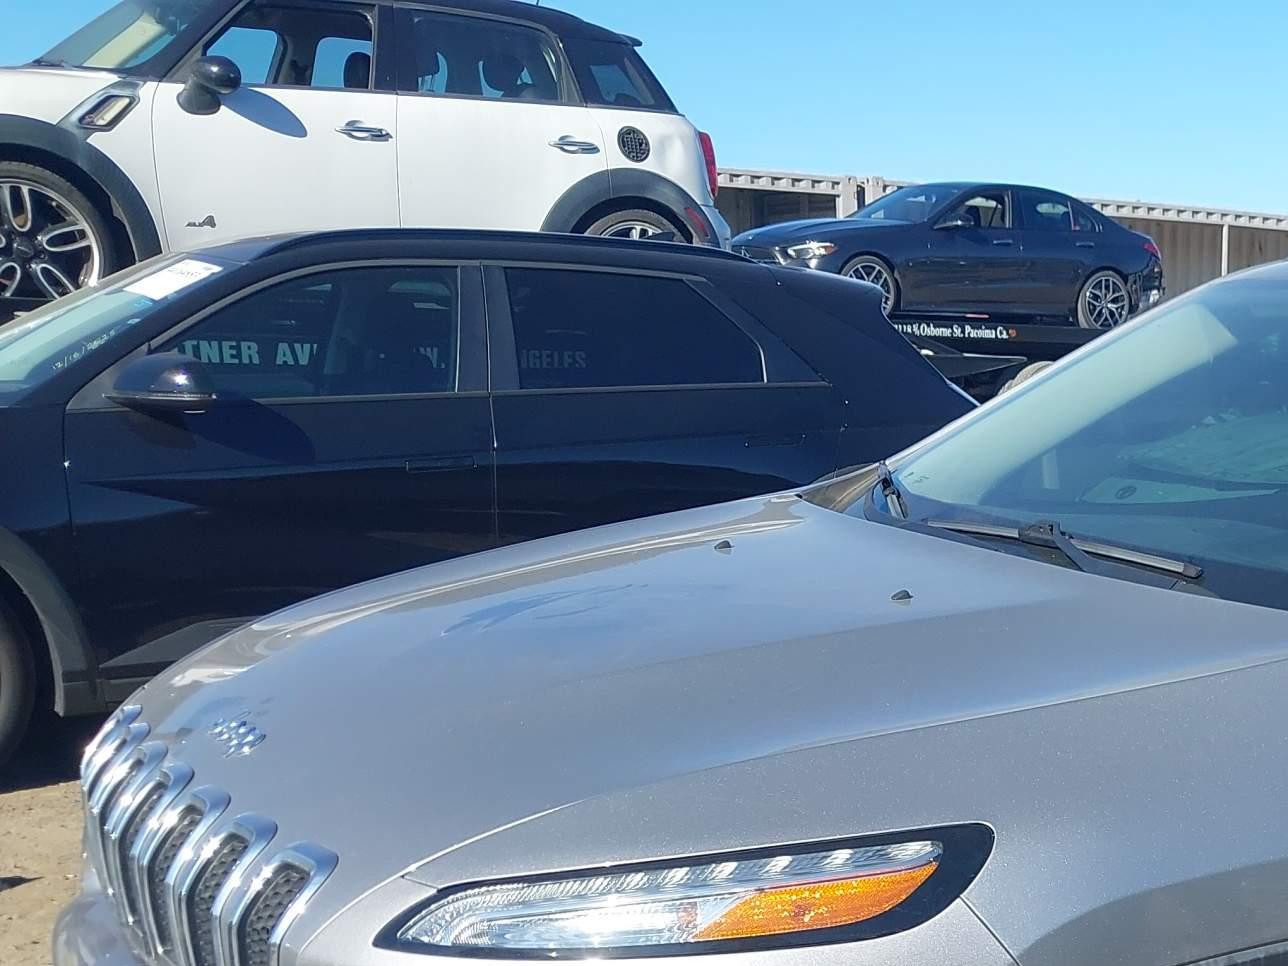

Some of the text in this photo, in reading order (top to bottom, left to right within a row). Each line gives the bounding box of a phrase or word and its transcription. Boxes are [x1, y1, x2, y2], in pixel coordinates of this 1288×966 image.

[920, 323, 952, 337] Osborne
[952, 325, 964, 338] St.
[965, 325, 996, 339] Pacoima
[173, 340, 318, 366] TNER AV
